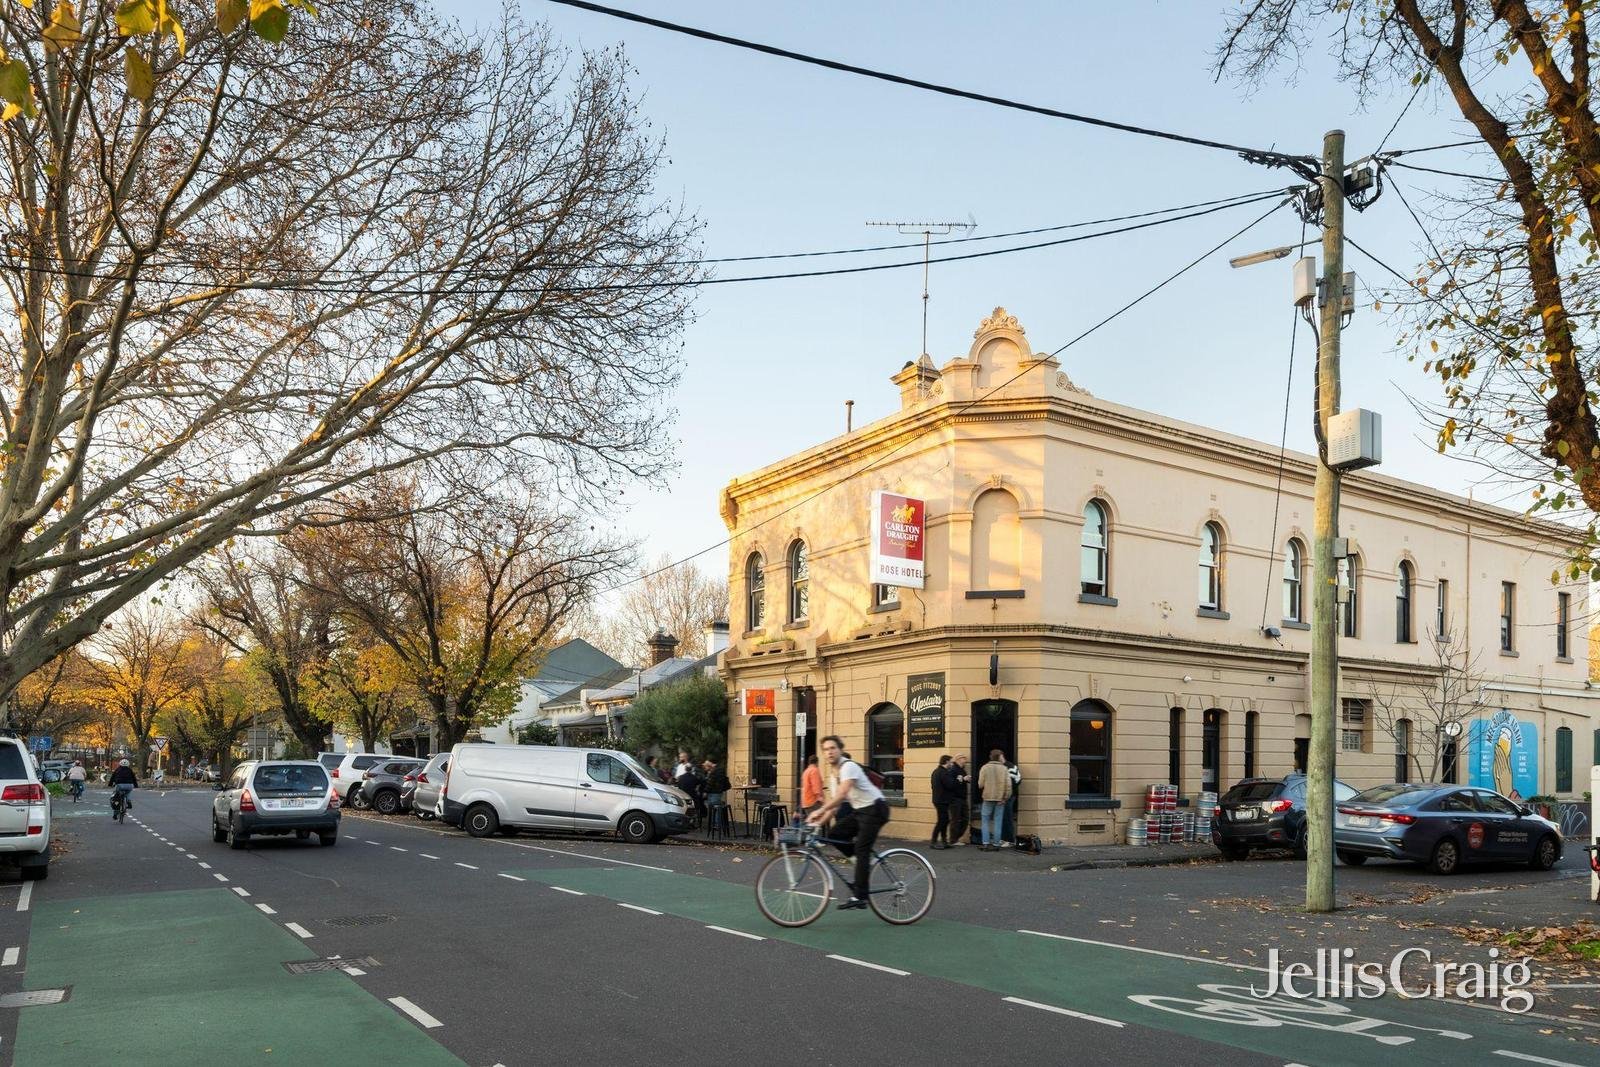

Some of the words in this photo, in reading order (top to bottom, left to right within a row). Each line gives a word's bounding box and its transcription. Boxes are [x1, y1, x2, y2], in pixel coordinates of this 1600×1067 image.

[885, 521, 920, 535] CARLTON
[886, 530, 919, 542] DRAUGHT
[880, 564, 899, 576] ROSE
[901, 567, 923, 579] HOTEL
[910, 693, 942, 713] Upstairs
